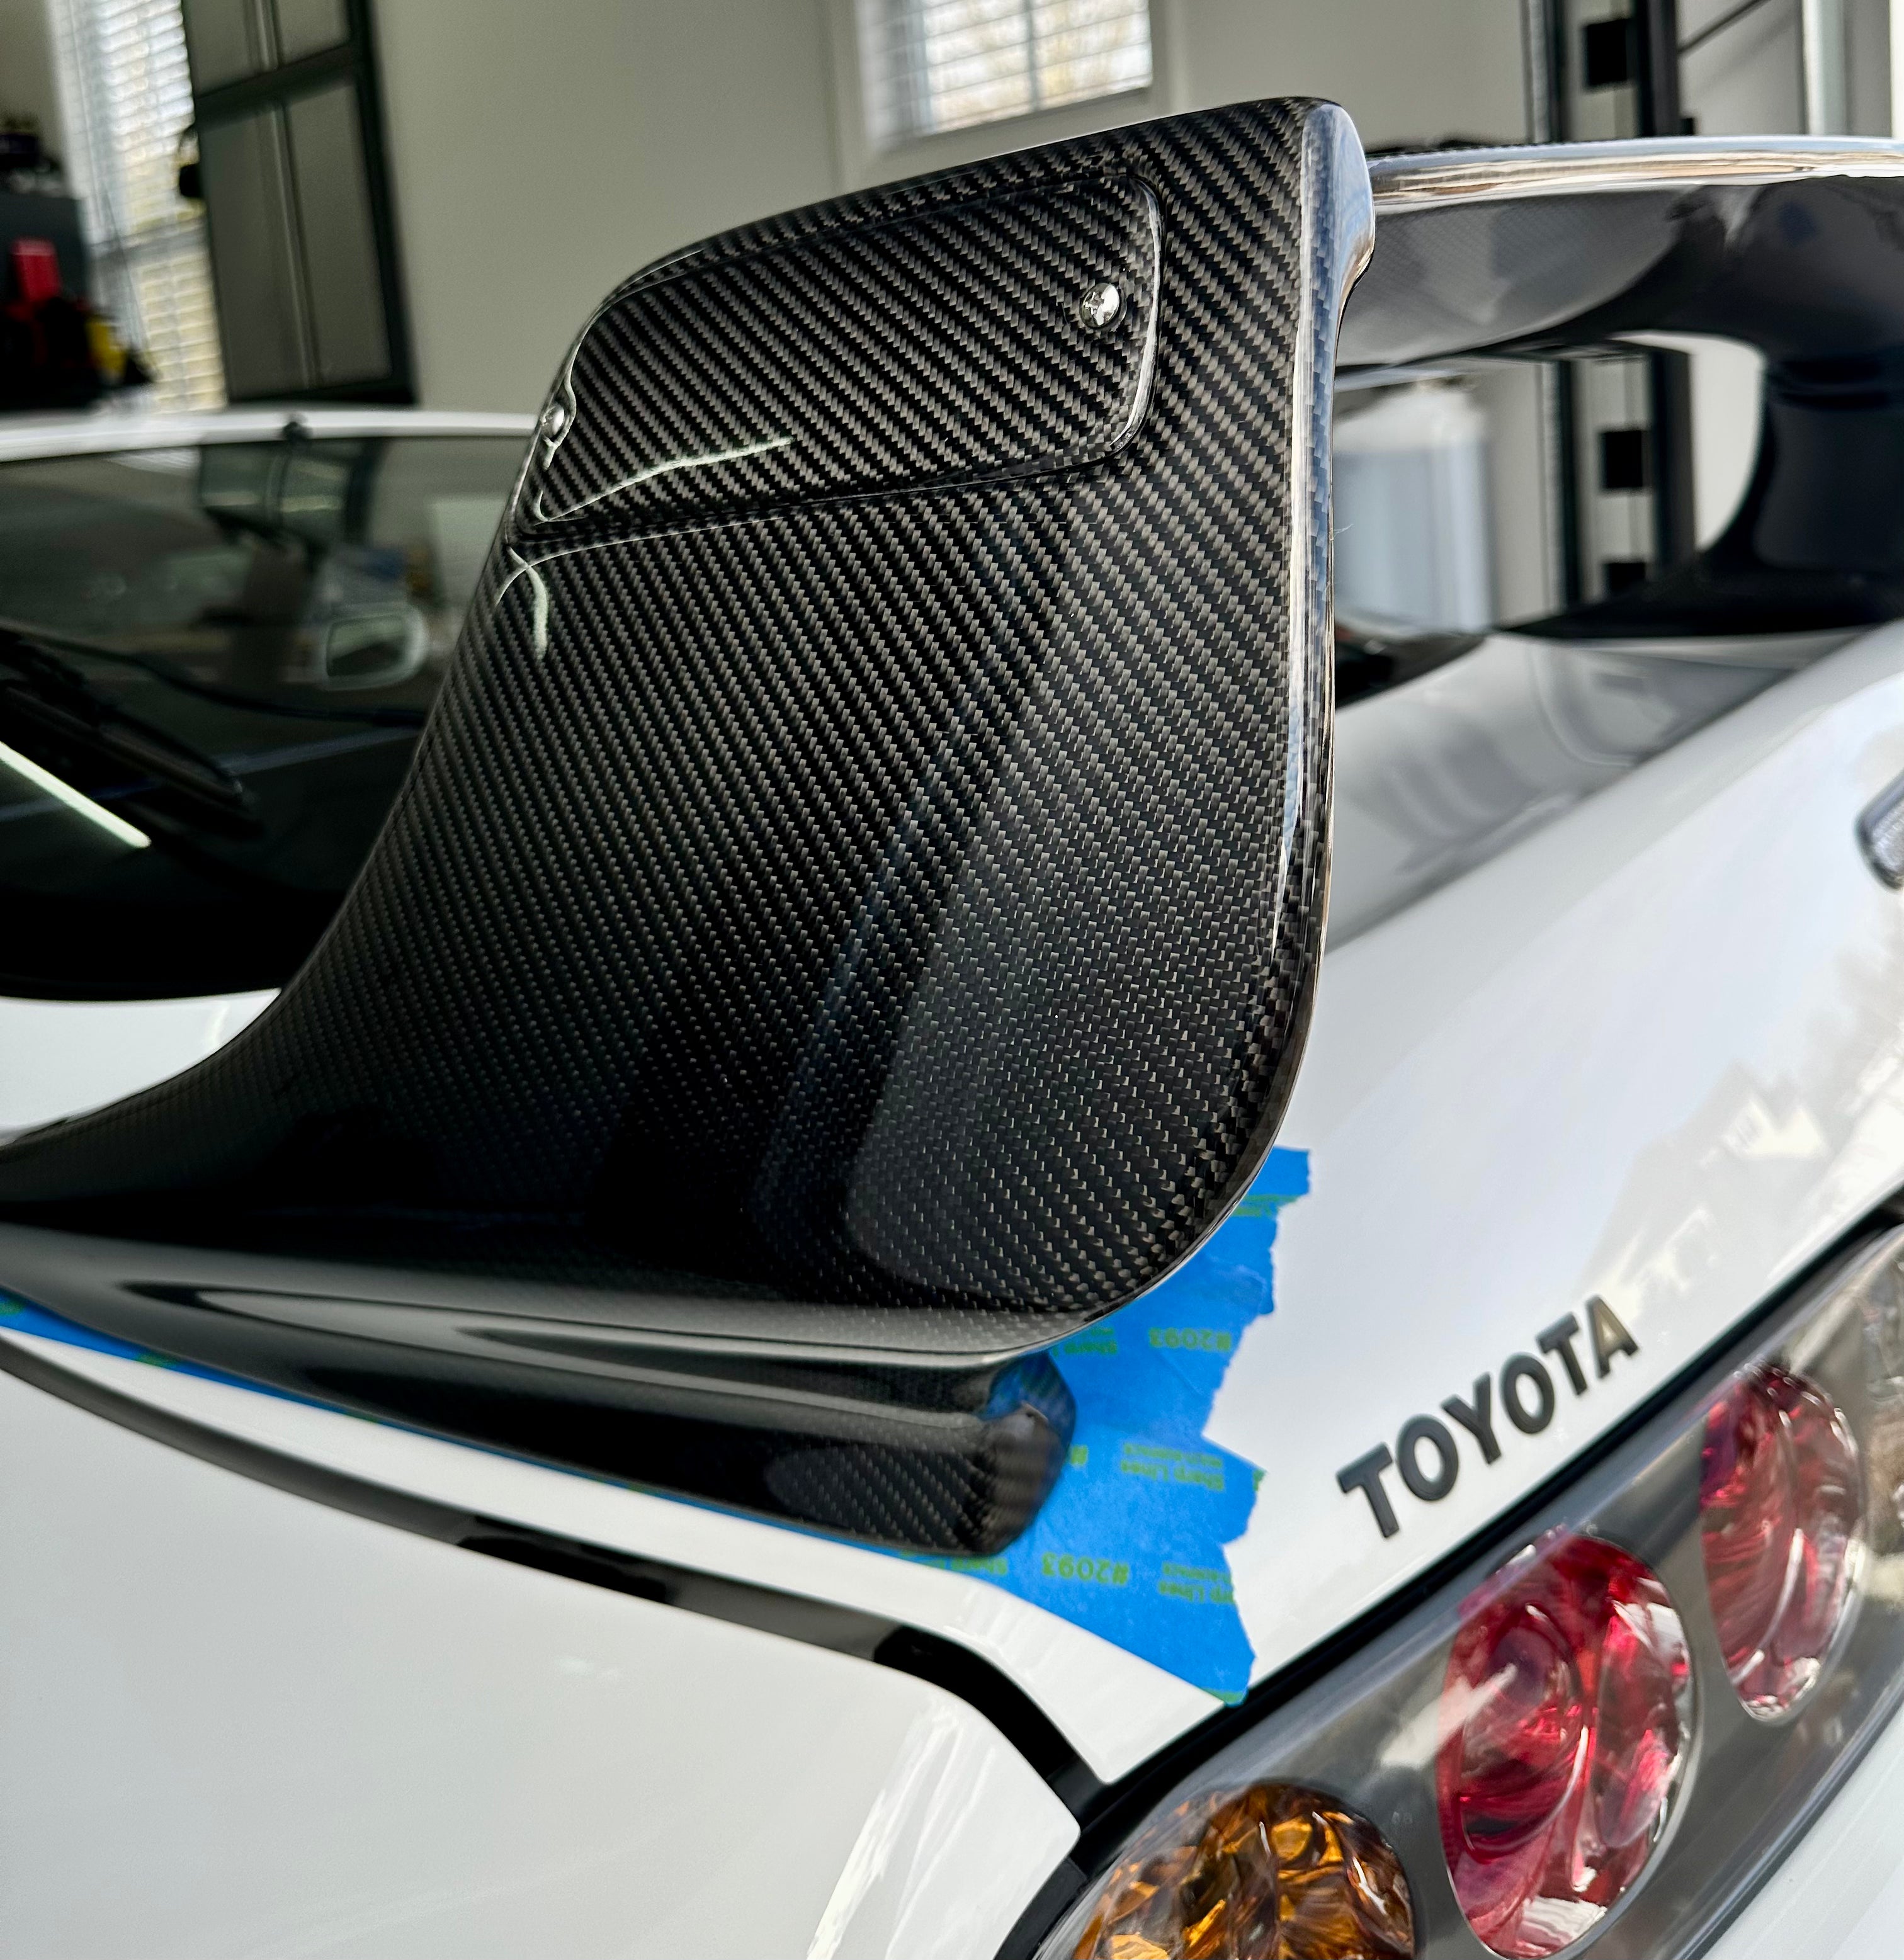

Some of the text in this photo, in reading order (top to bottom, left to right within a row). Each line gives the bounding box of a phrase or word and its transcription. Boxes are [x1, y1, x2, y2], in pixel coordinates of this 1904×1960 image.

[1148, 1327, 1232, 1351] #2093
[1335, 1293, 1640, 1539] TOYOTA
[1041, 1553, 1130, 1585] #2093
